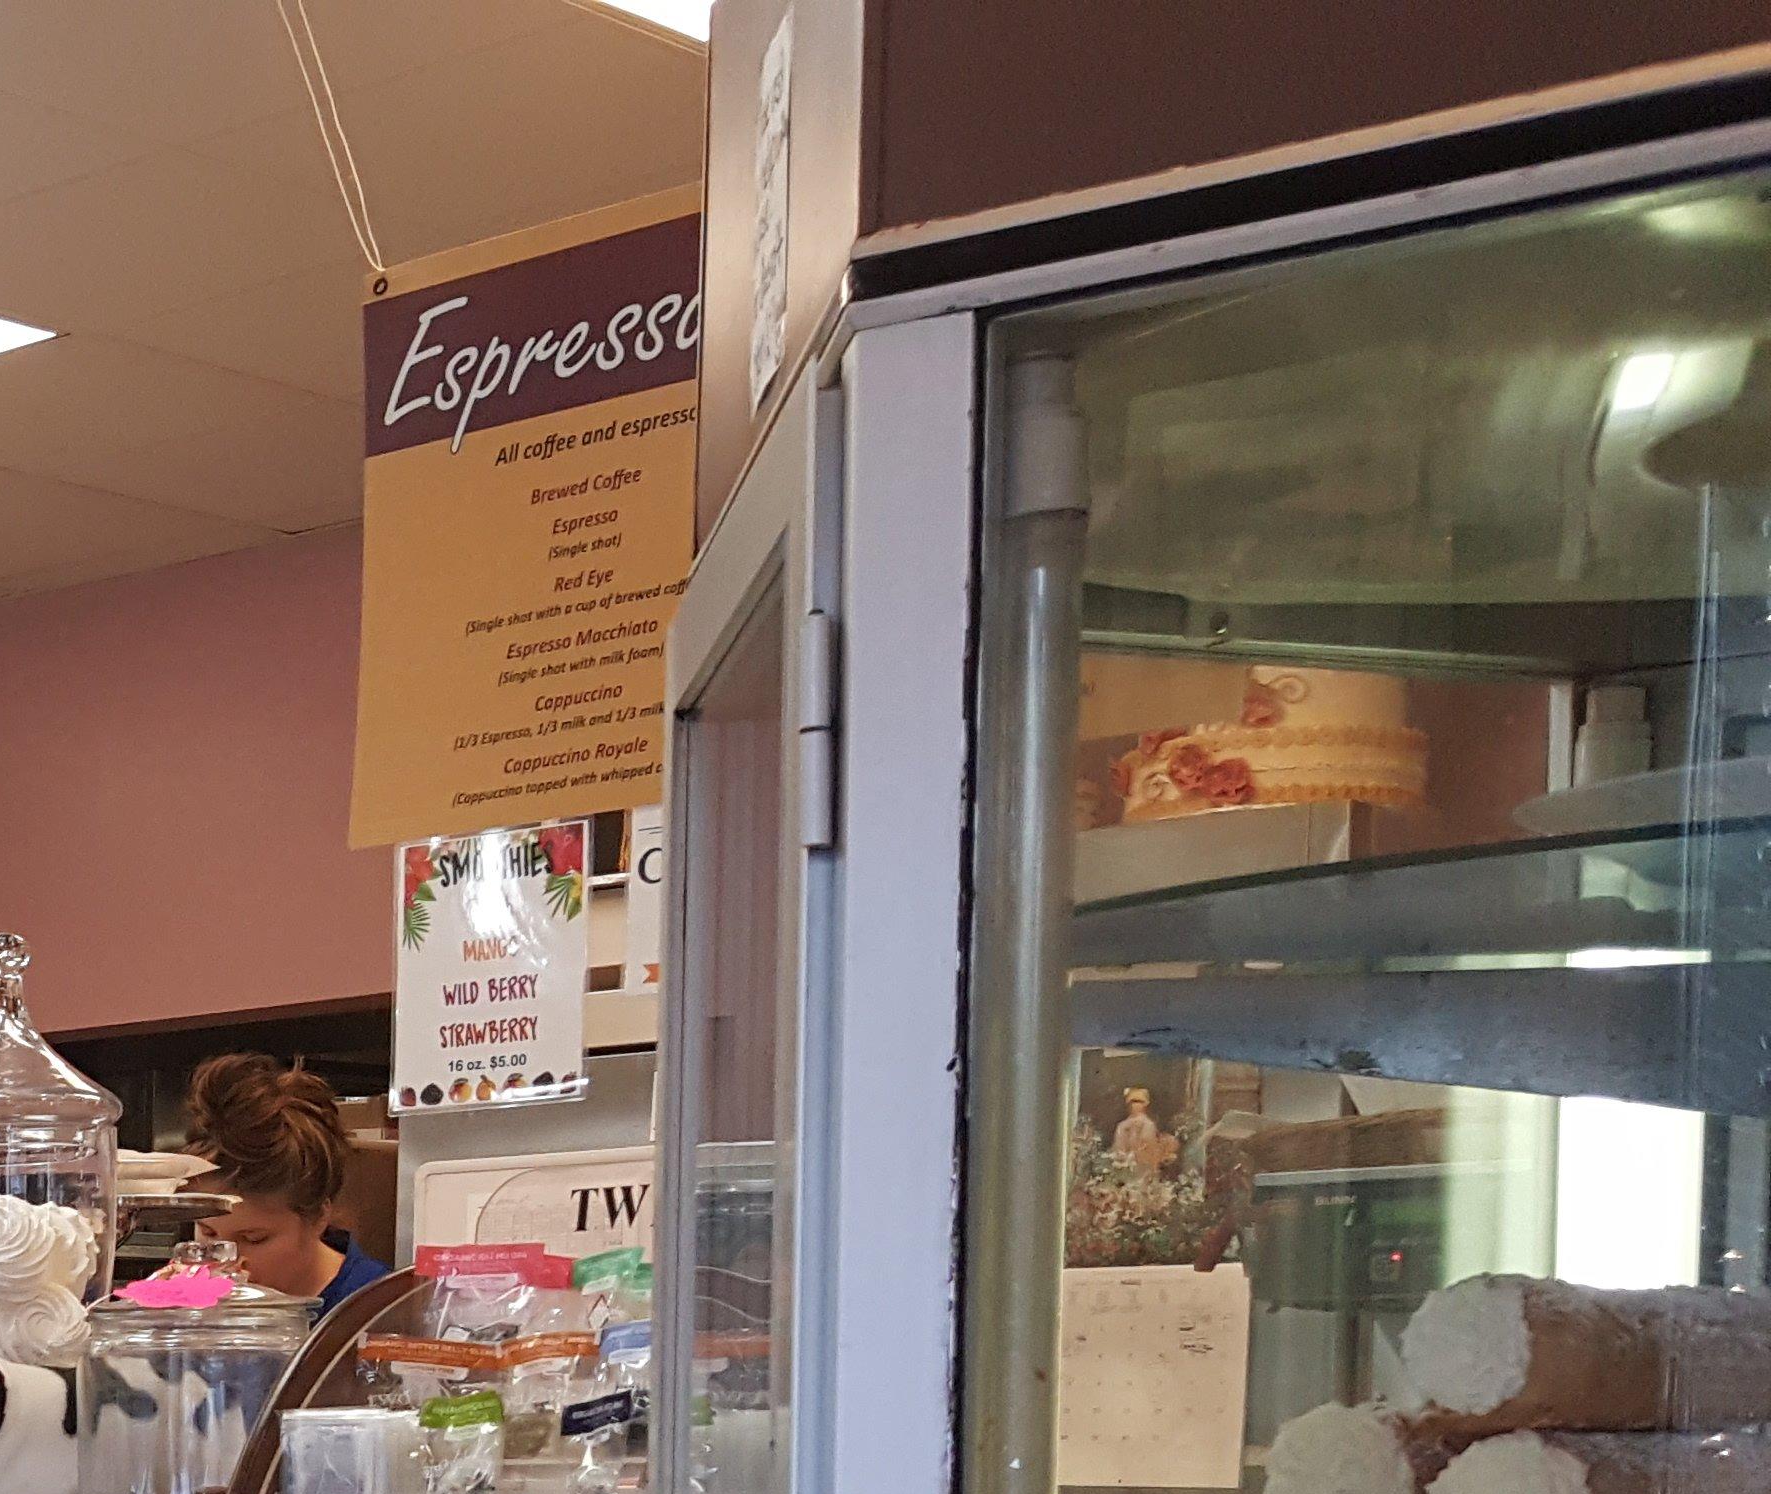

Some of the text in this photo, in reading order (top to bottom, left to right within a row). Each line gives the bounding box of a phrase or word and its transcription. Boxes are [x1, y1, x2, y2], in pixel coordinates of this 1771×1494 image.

[495, 443, 519, 466] All
[523, 433, 577, 460] coffee
[582, 420, 617, 444] and
[530, 468, 642, 505] Brewed Coffee
[552, 509, 618, 535] Espresso
[553, 568, 614, 592] Red Eye
[507, 611, 532, 626] shot
[535, 605, 561, 621] with
[565, 605, 572, 615] a
[575, 599, 597, 614] cup
[599, 595, 613, 610] of
[614, 585, 661, 605] brewed
[506, 618, 659, 660] Espresso Macchiato
[540, 663, 566, 677] shot
[569, 657, 596, 672] with
[599, 651, 624, 667] milk
[534, 683, 623, 714] Cappuccino
[536, 720, 558, 737] 1/3
[560, 715, 585, 731] milk
[589, 710, 612, 726] and
[615, 705, 636, 723] 1/3
[503, 736, 648, 774] Cappuccino Royale
[526, 777, 567, 796] topped
[570, 771, 597, 787] with
[600, 761, 654, 784] whipped
[443, 974, 539, 1007] WILD BERRY
[439, 1016, 539, 1048] STRAWBERRY
[448, 1053, 527, 1072] 16 oz. $5.00
